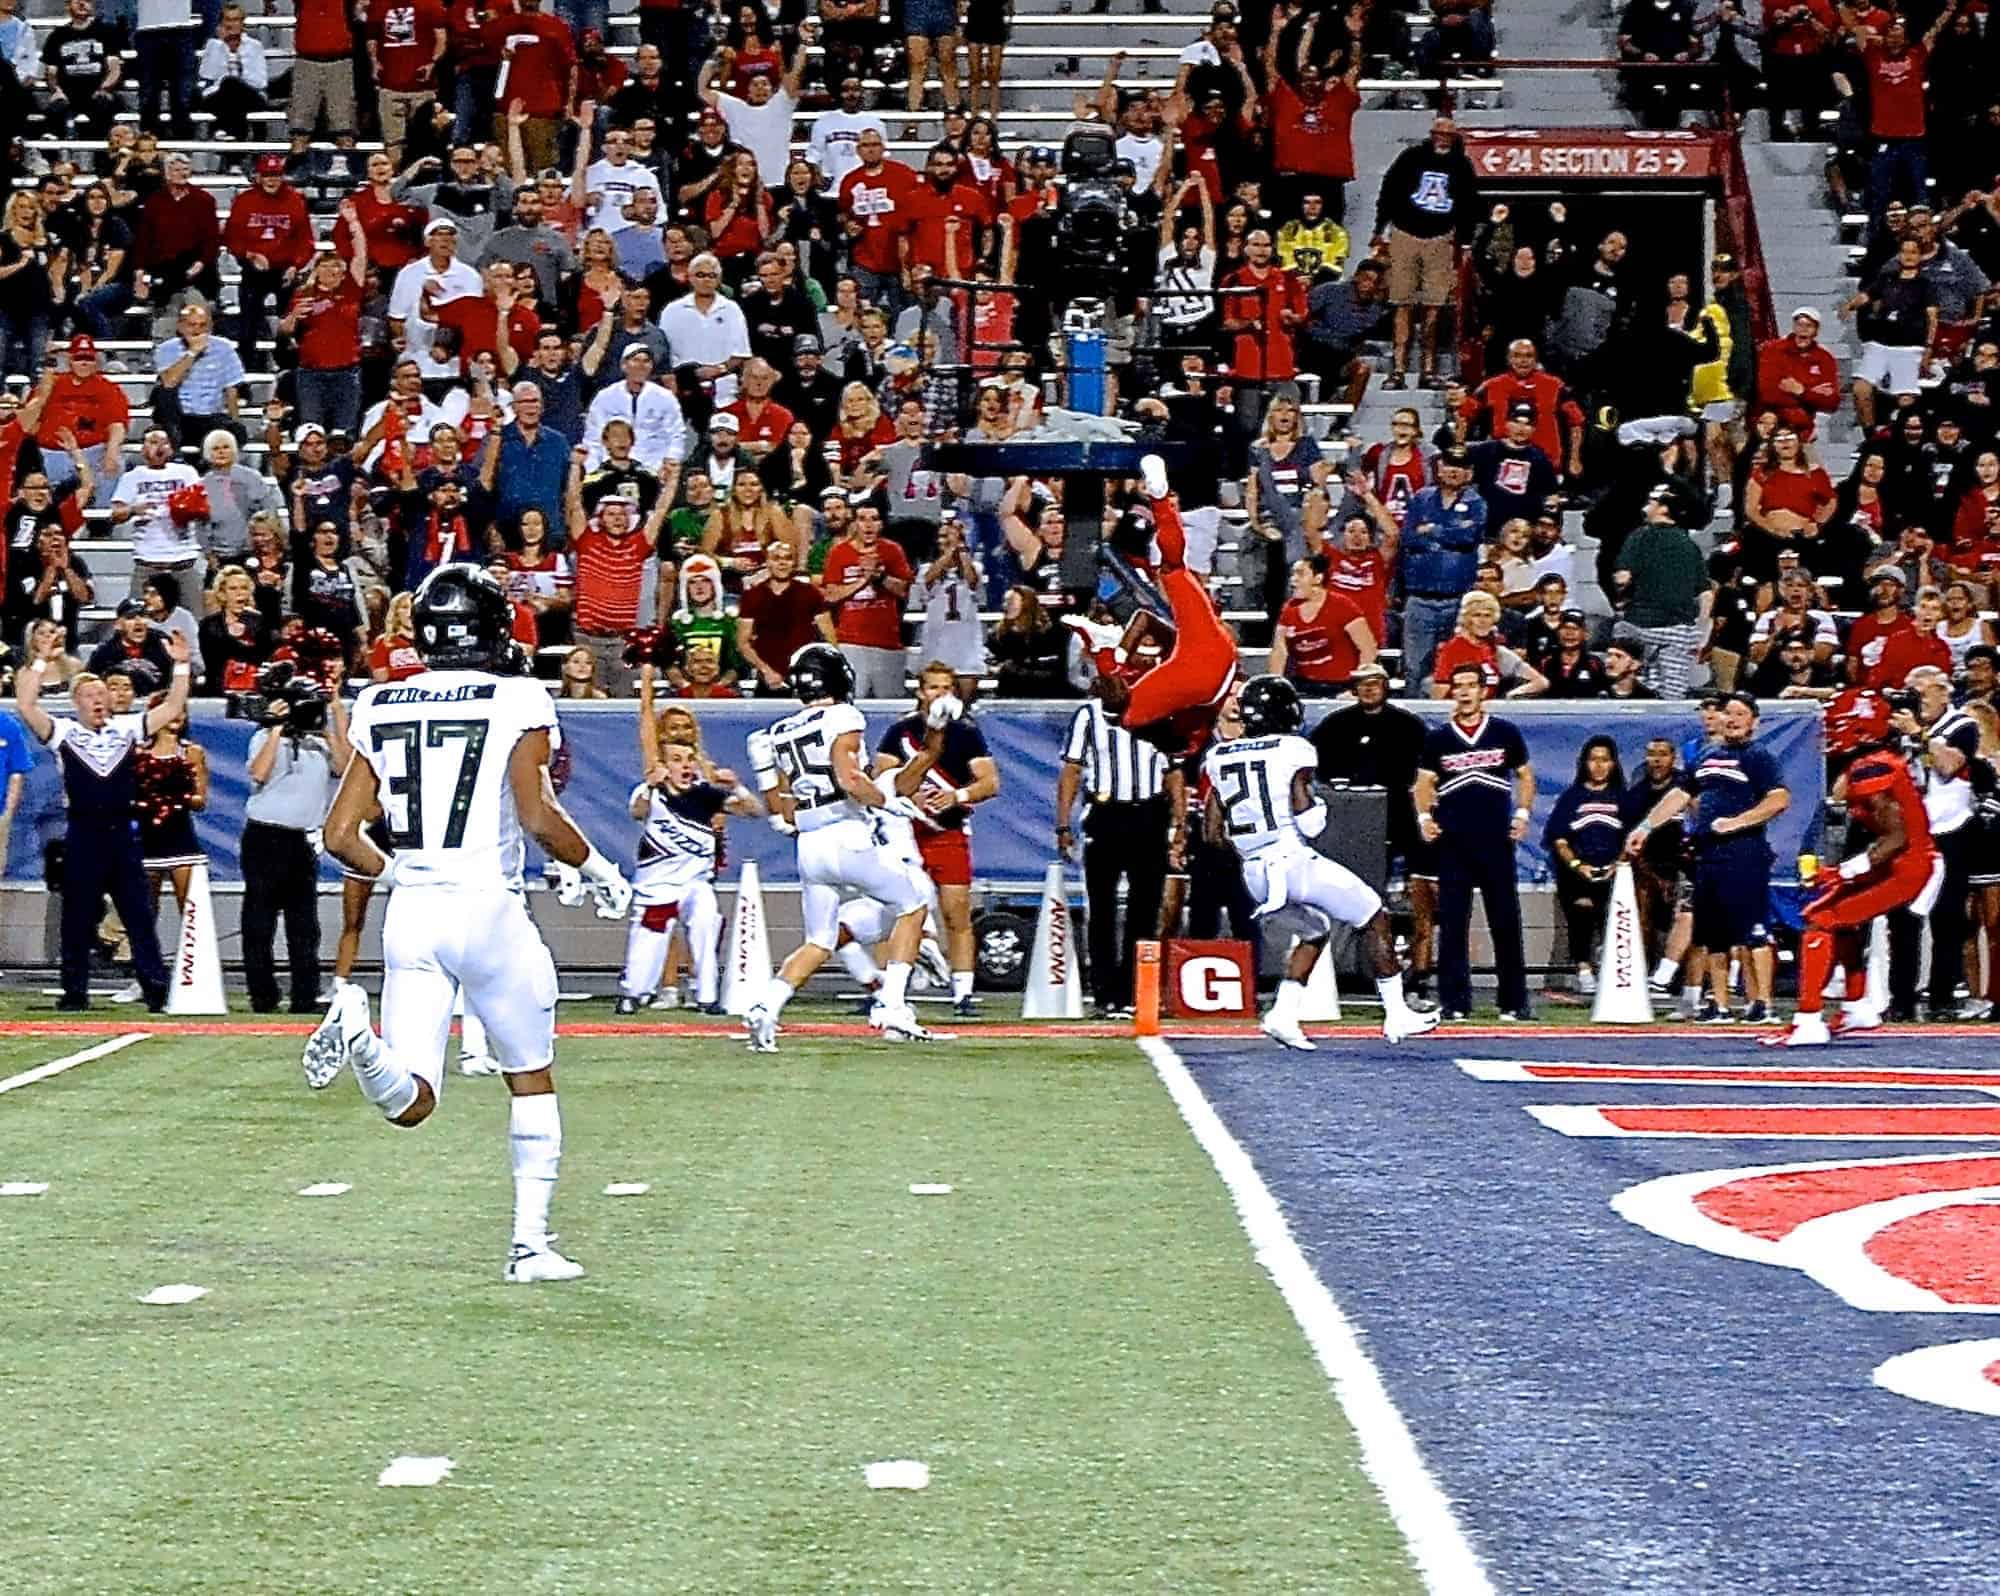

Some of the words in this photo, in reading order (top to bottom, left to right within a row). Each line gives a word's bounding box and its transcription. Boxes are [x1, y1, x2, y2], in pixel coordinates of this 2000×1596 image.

[1507, 148, 1533, 172] 24
[1540, 147, 1629, 172] SECTION
[1634, 147, 1662, 172] 25
[944, 583, 962, 622] 1
[369, 718, 490, 850] 37
[1220, 760, 1278, 837] 21
[1050, 898, 1067, 986] ARIZONA
[1614, 900, 1632, 989] ARIZONA
[1179, 956, 1244, 1013] G
